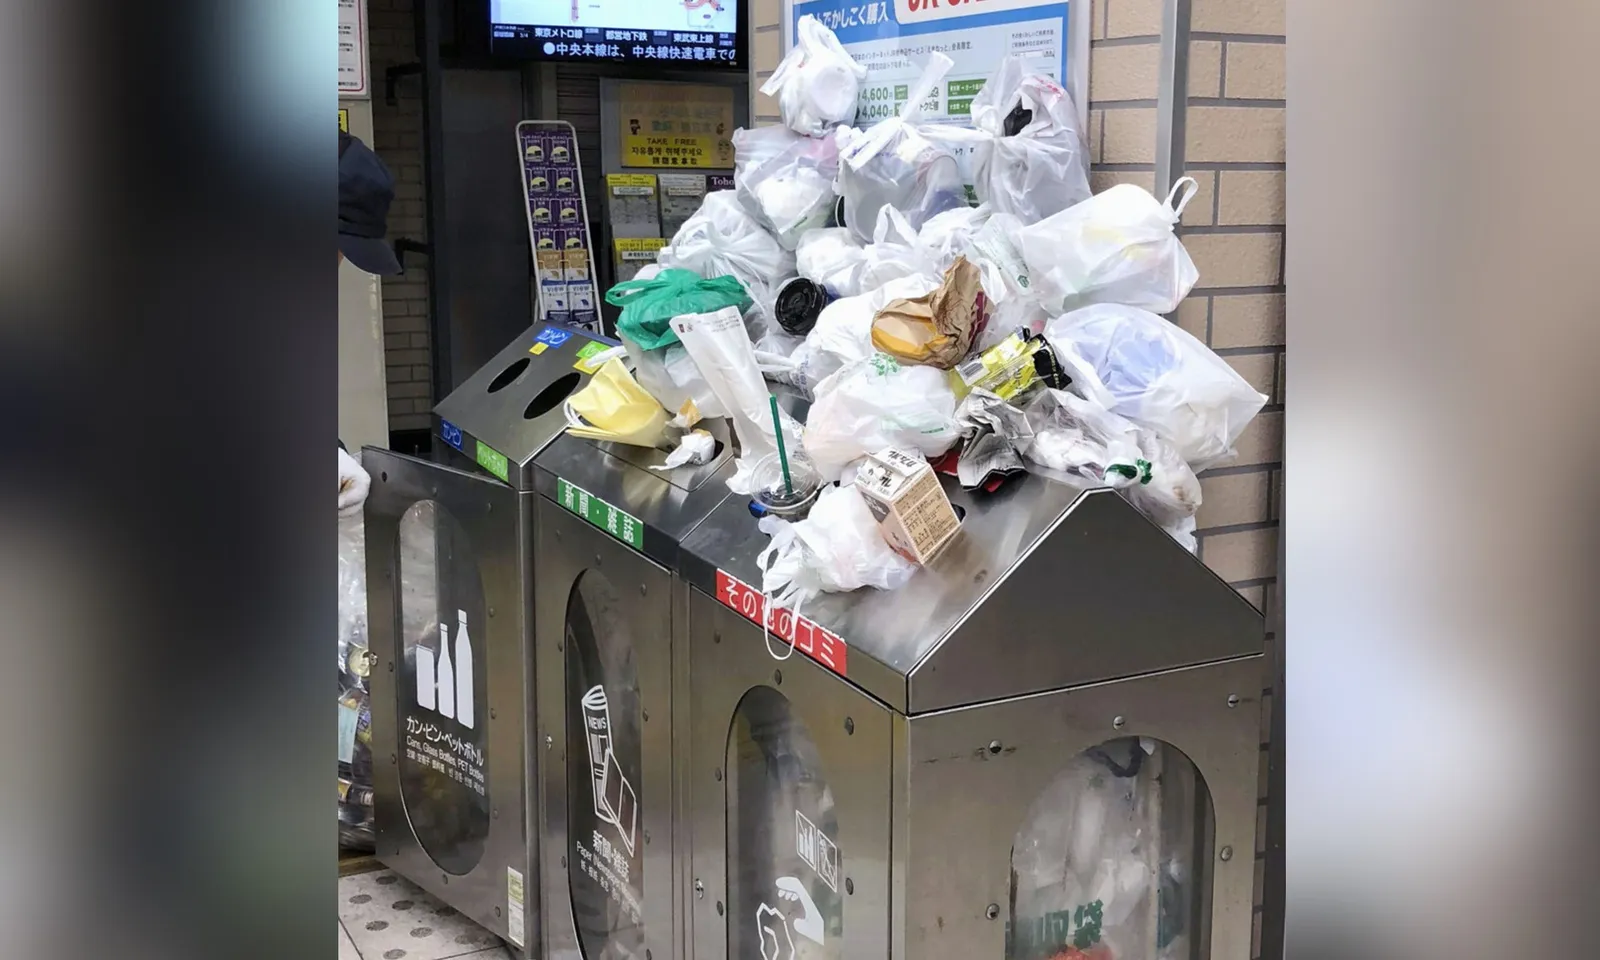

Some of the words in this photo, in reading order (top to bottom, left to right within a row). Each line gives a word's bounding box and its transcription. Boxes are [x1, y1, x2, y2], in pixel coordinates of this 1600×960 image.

[534, 27, 583, 39] 東京メトロ線
[605, 30, 648, 41] 都営地下鉄
[673, 33, 714, 43] 東武東上線
[647, 137, 668, 145] TAKE
[674, 138, 697, 146] FREE
[564, 483, 635, 543] 新聞・雑誌
[587, 715, 607, 730] NEWS
[406, 715, 485, 767] カン・ビン・ペットボトル
